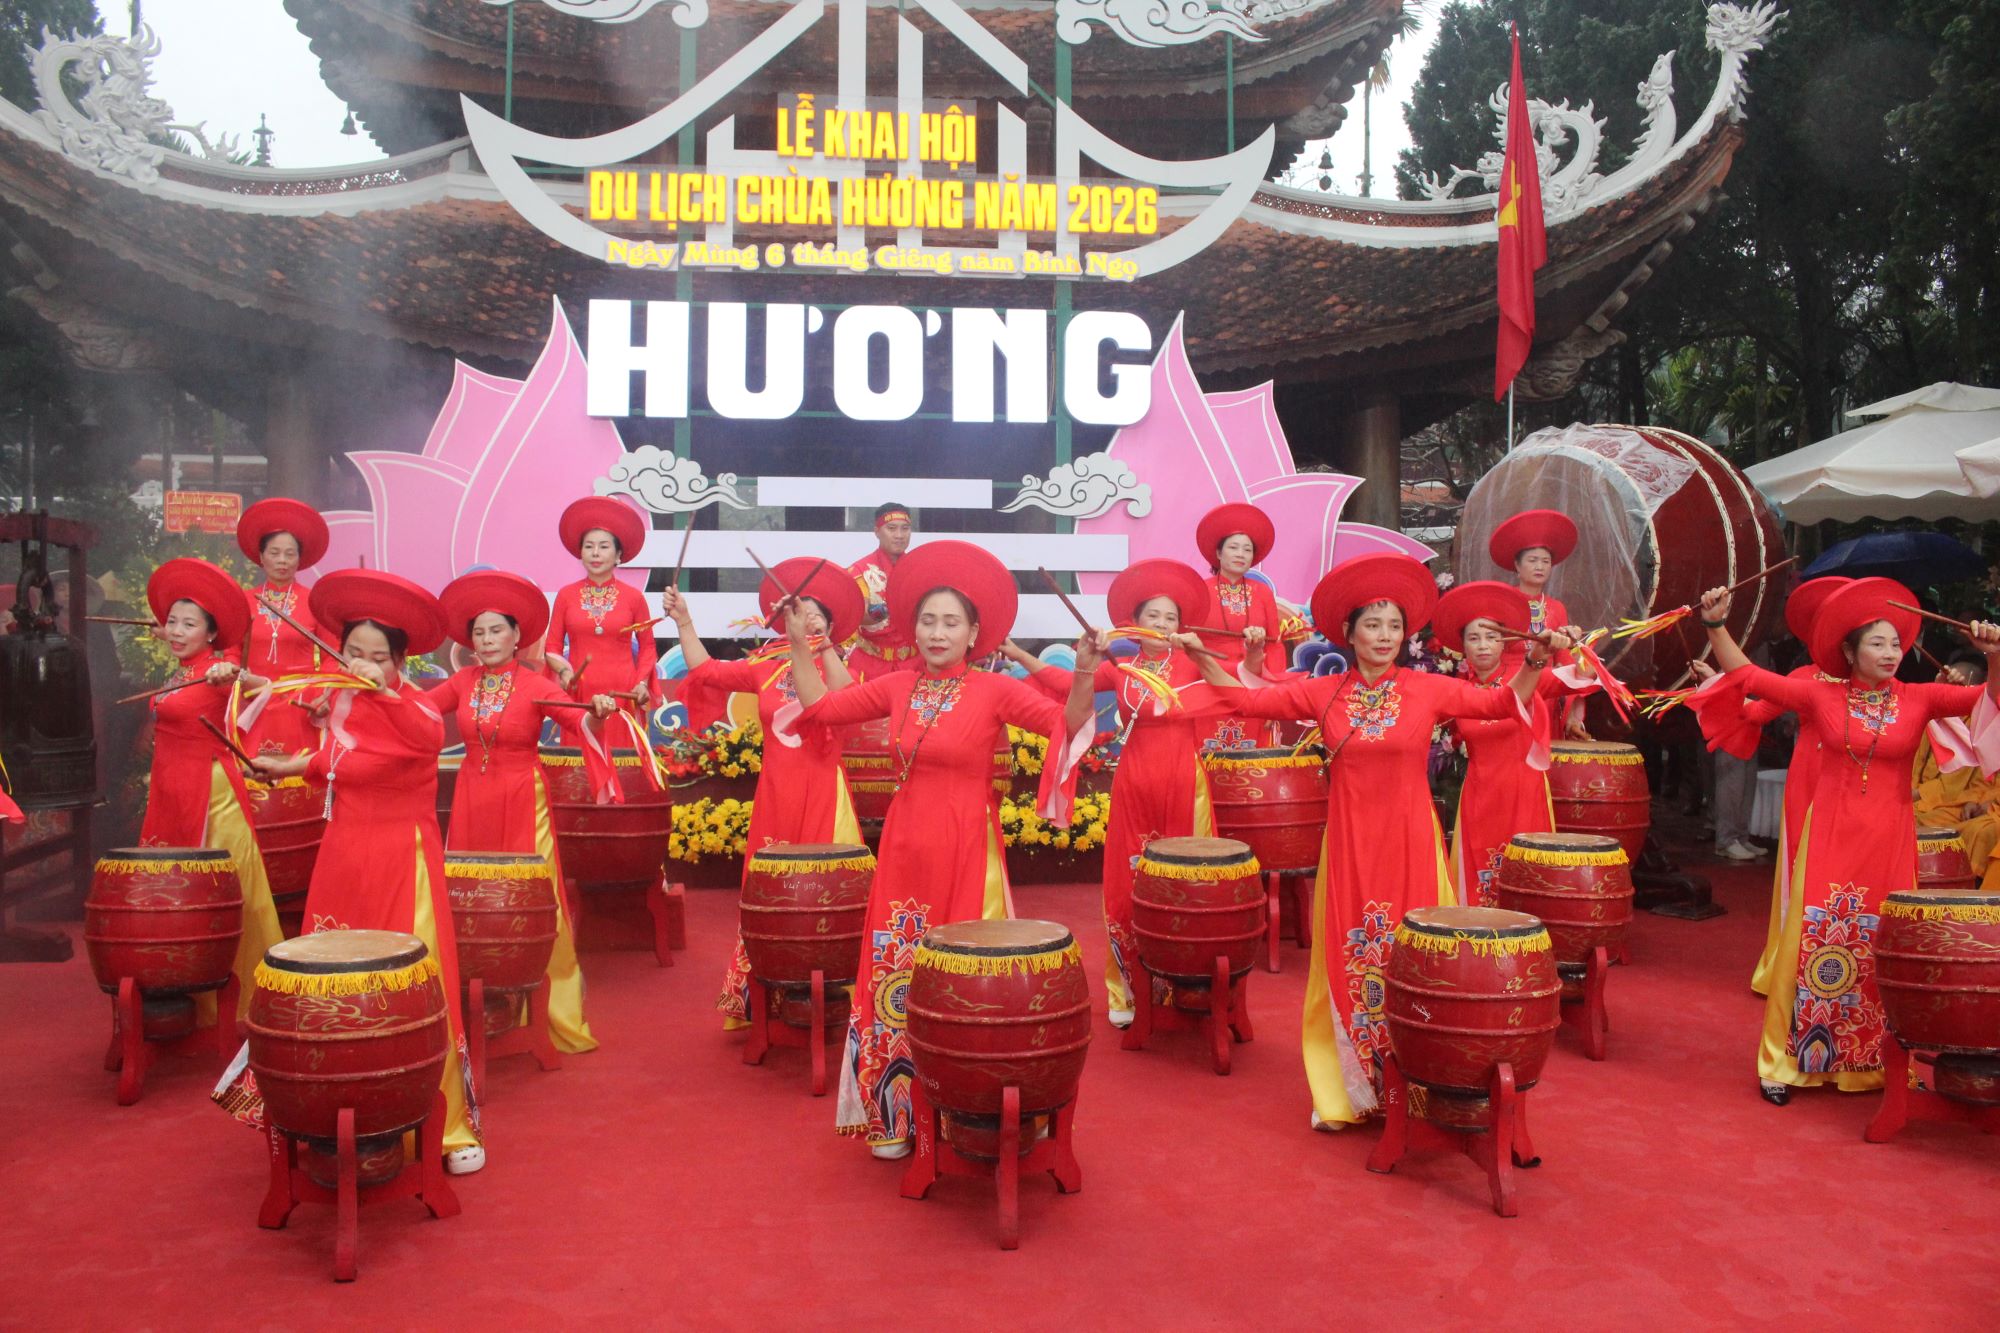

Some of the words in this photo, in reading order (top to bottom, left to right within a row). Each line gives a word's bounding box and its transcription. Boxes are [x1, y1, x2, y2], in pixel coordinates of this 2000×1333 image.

[777, 93, 815, 157] LỄ
[824, 109, 909, 160] KHAI
[919, 104, 976, 170] HỘI
[590, 171, 638, 220] DU
[650, 172, 726, 231] LỊCH
[736, 165, 832, 224] CHÙA
[842, 172, 963, 229] HƯƠNG
[974, 173, 1057, 231] NĂM
[1067, 185, 1158, 234] 2026
[607, 241, 676, 268] Ngày
[683, 241, 759, 269] Mùng
[765, 242, 785, 267] 6
[792, 241, 869, 271] tháng
[874, 245, 953, 274] Giêng
[960, 252, 1016, 273] năm
[1085, 252, 1138, 282] Ngọ
[586, 298, 1153, 426] HƯƠNG
